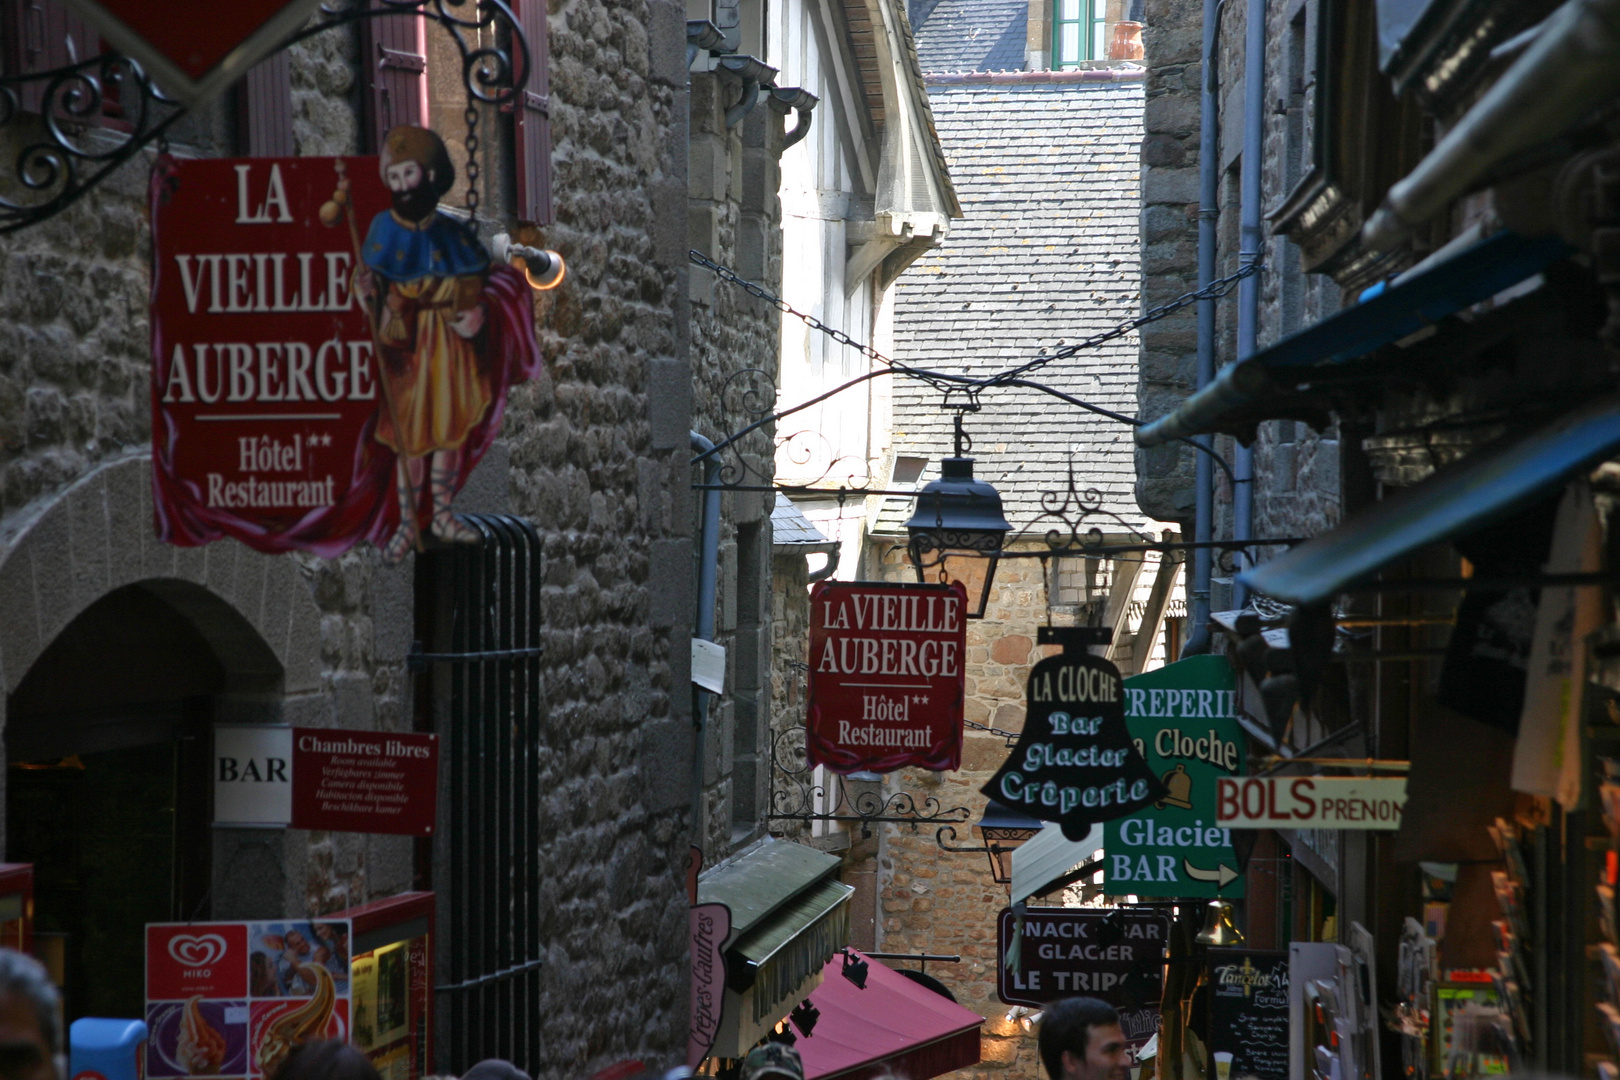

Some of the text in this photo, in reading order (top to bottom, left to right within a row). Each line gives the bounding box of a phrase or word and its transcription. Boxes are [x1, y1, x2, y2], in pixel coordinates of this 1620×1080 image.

[234, 163, 294, 224] LA
[174, 251, 353, 314] VIEILLE
[161, 339, 376, 403] AUBERGE
[238, 434, 302, 472] Hôtel
[206, 473, 335, 508] Restaurant
[822, 593, 959, 633] LA VIEILLE
[817, 636, 958, 677] AUBERGE
[1034, 665, 1118, 702] LA CLOCHE
[862, 695, 909, 721] Hôtel
[1048, 711, 1104, 735] Bar
[298, 735, 430, 759] Chambres libres
[838, 720, 932, 747] Restaurant
[330, 756, 398, 768] Room available
[1022, 742, 1130, 772] Glacier
[1154, 728, 1238, 771] Cloche
[218, 757, 288, 782] BAR
[1217, 779, 1317, 821] BOLS
[1110, 854, 1178, 882] BAR
[1037, 943, 1134, 961] GLACIER
[183, 968, 211, 979] MIKO
[1013, 970, 1041, 990] LE
